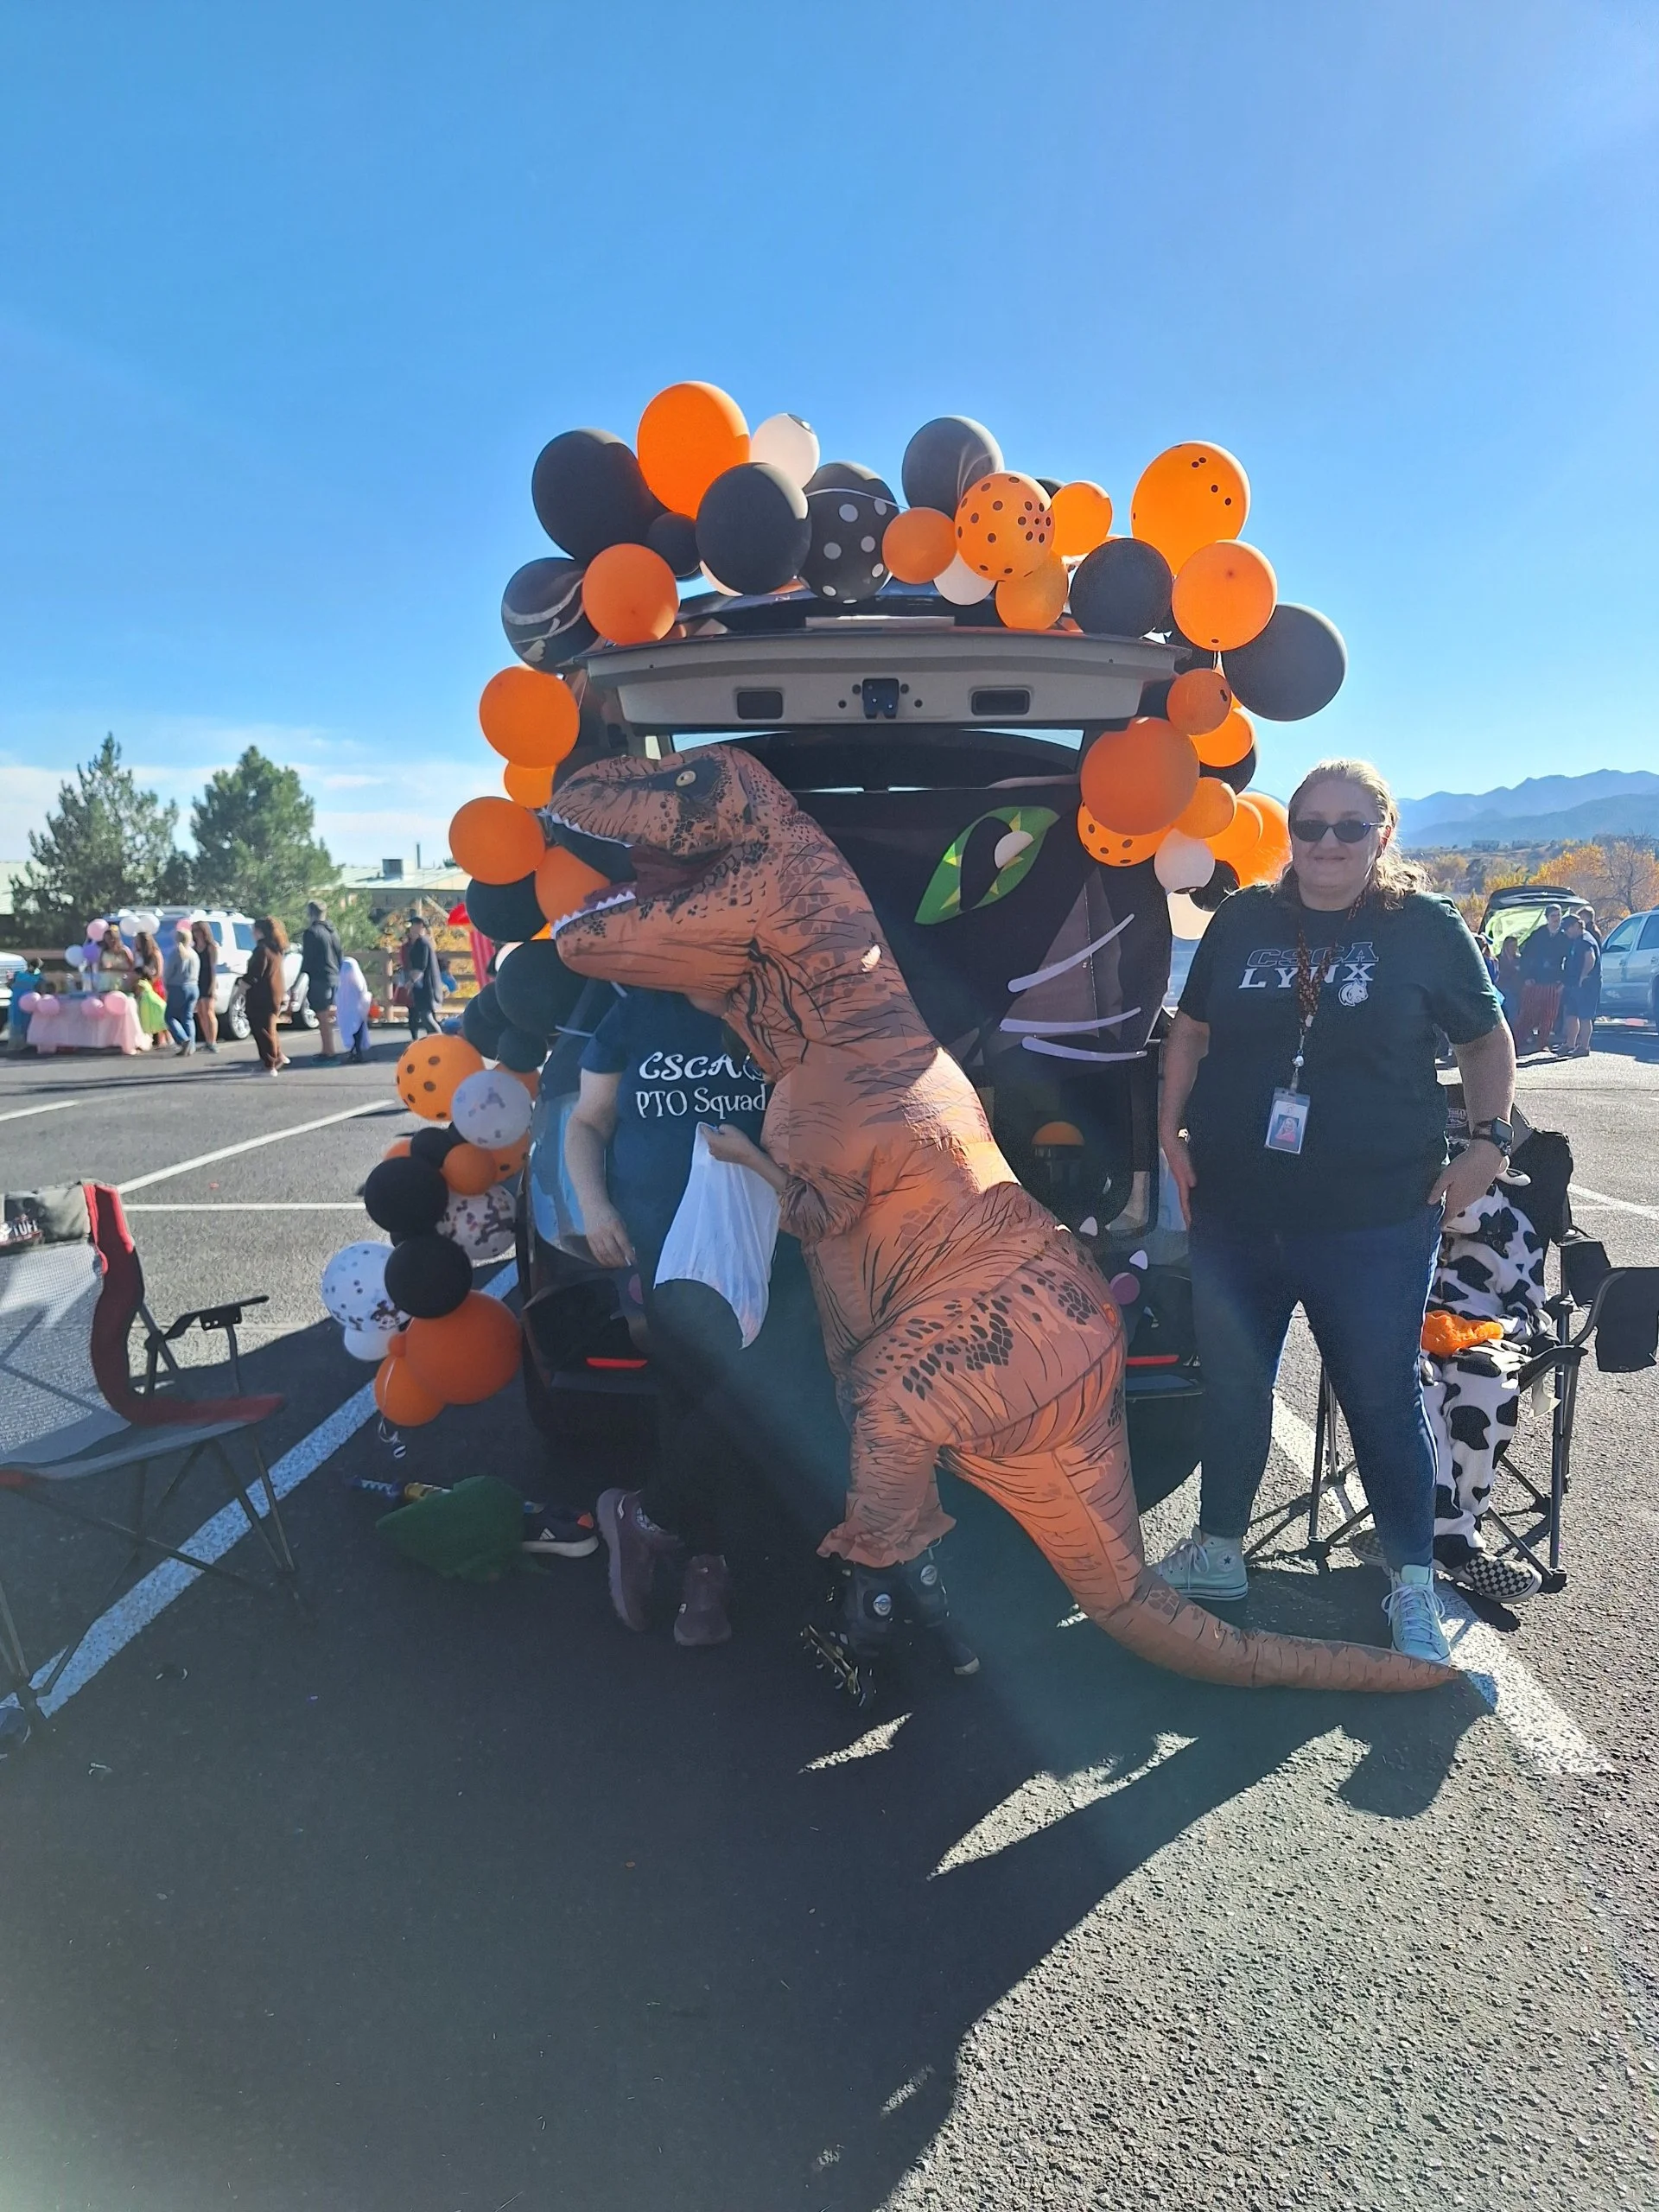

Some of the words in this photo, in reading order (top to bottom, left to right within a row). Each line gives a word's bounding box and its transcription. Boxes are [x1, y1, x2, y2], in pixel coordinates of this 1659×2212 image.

[639, 1051, 742, 1081] CSCA
[636, 1090, 688, 1119] PTO
[694, 1083, 767, 1120] Squad
